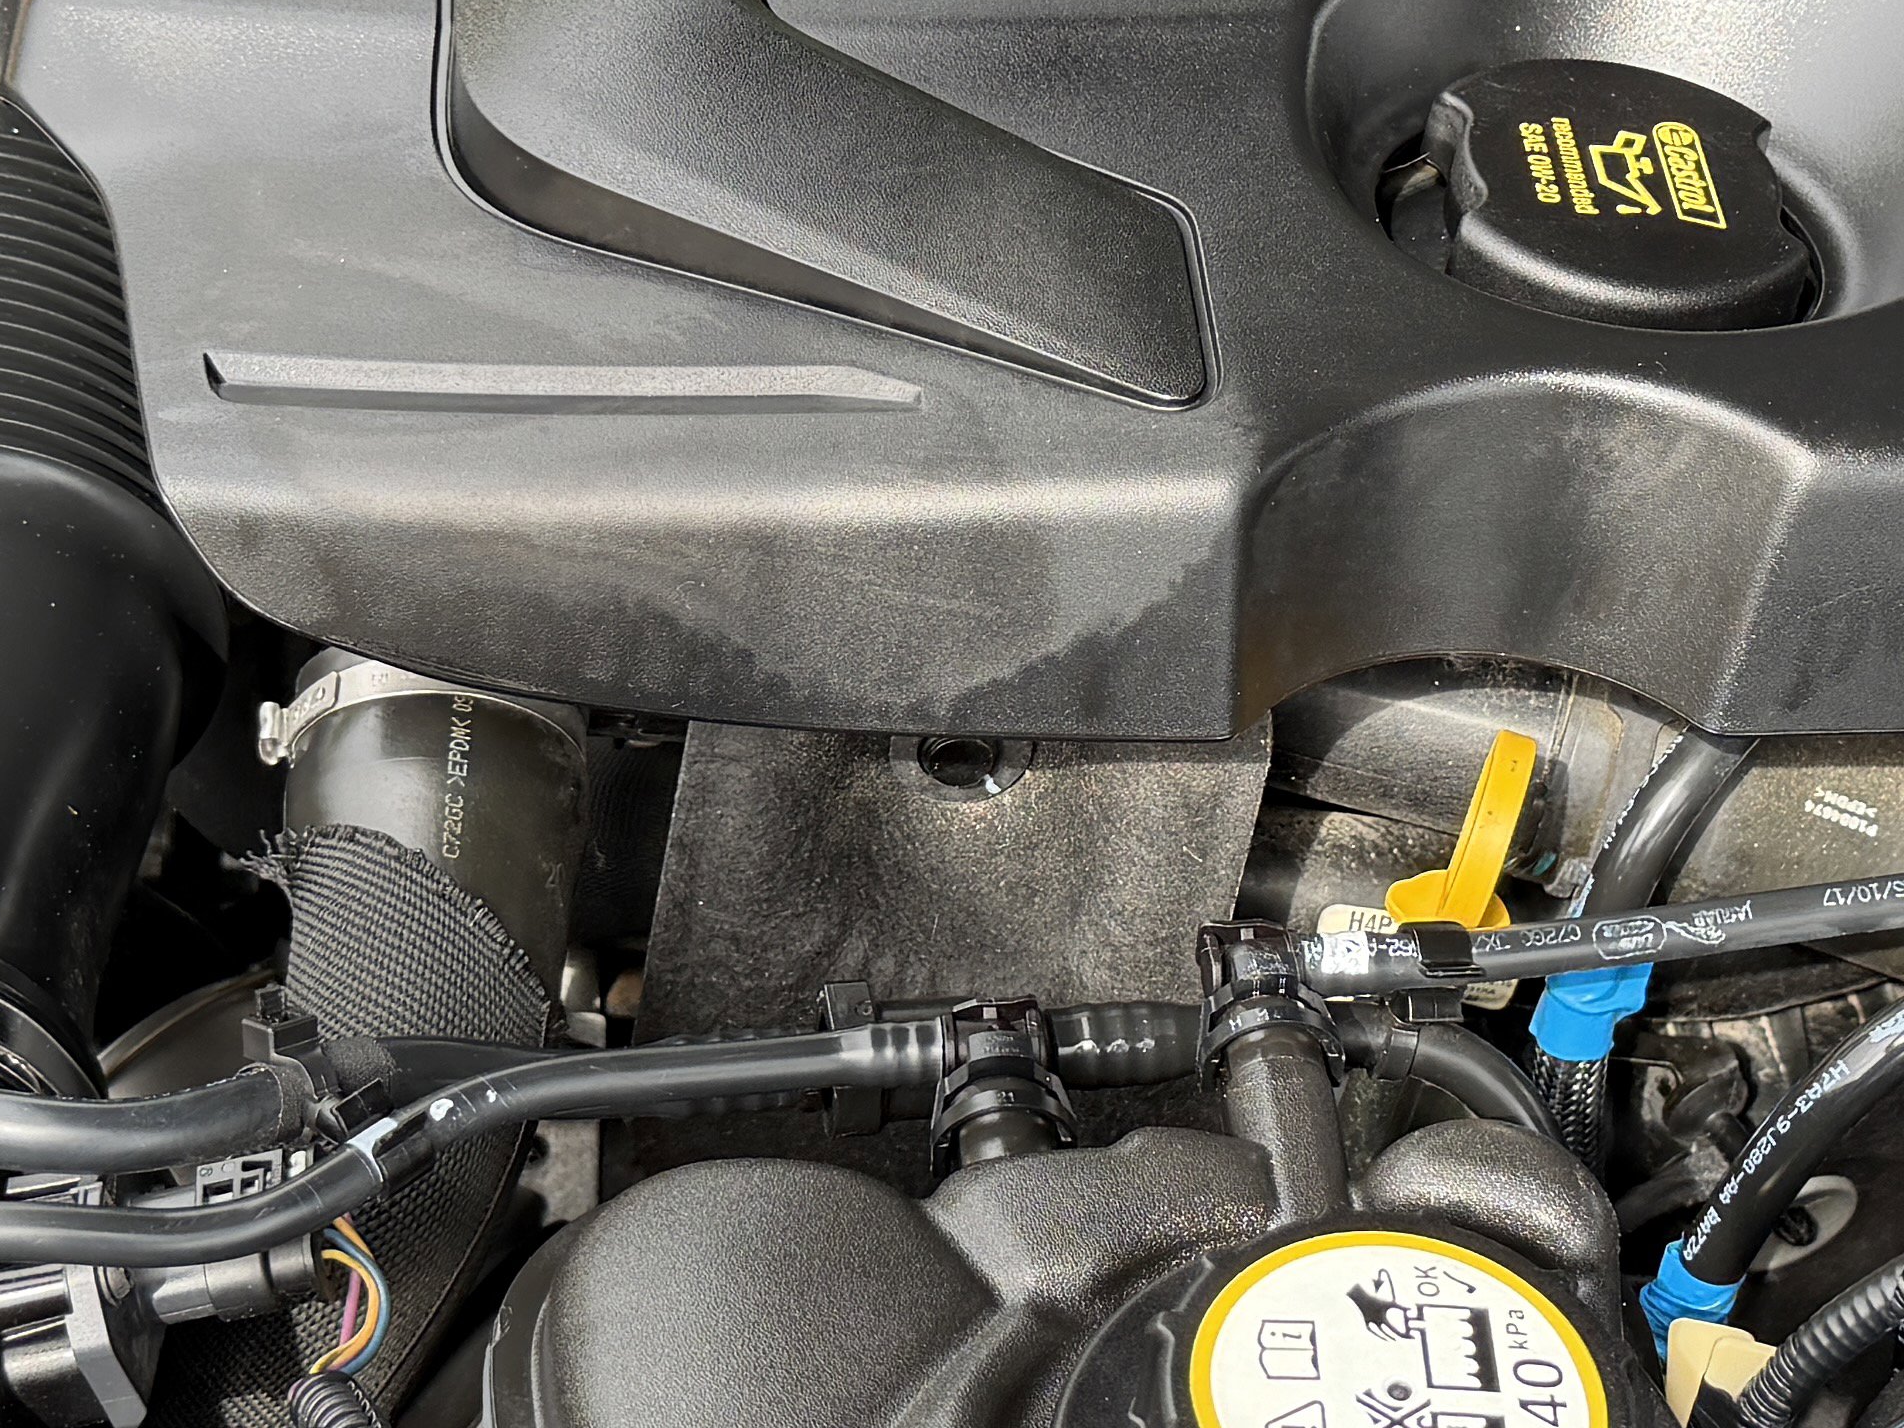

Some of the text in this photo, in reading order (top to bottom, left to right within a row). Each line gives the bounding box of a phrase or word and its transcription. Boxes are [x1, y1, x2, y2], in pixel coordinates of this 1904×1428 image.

[1518, 122, 1562, 204] SAE 0W-20
[1550, 116, 1600, 215] recommended
[1663, 144, 1716, 214] Castrol
[1414, 1263, 1440, 1298] OK
[1505, 1308, 1526, 1351] kPa
